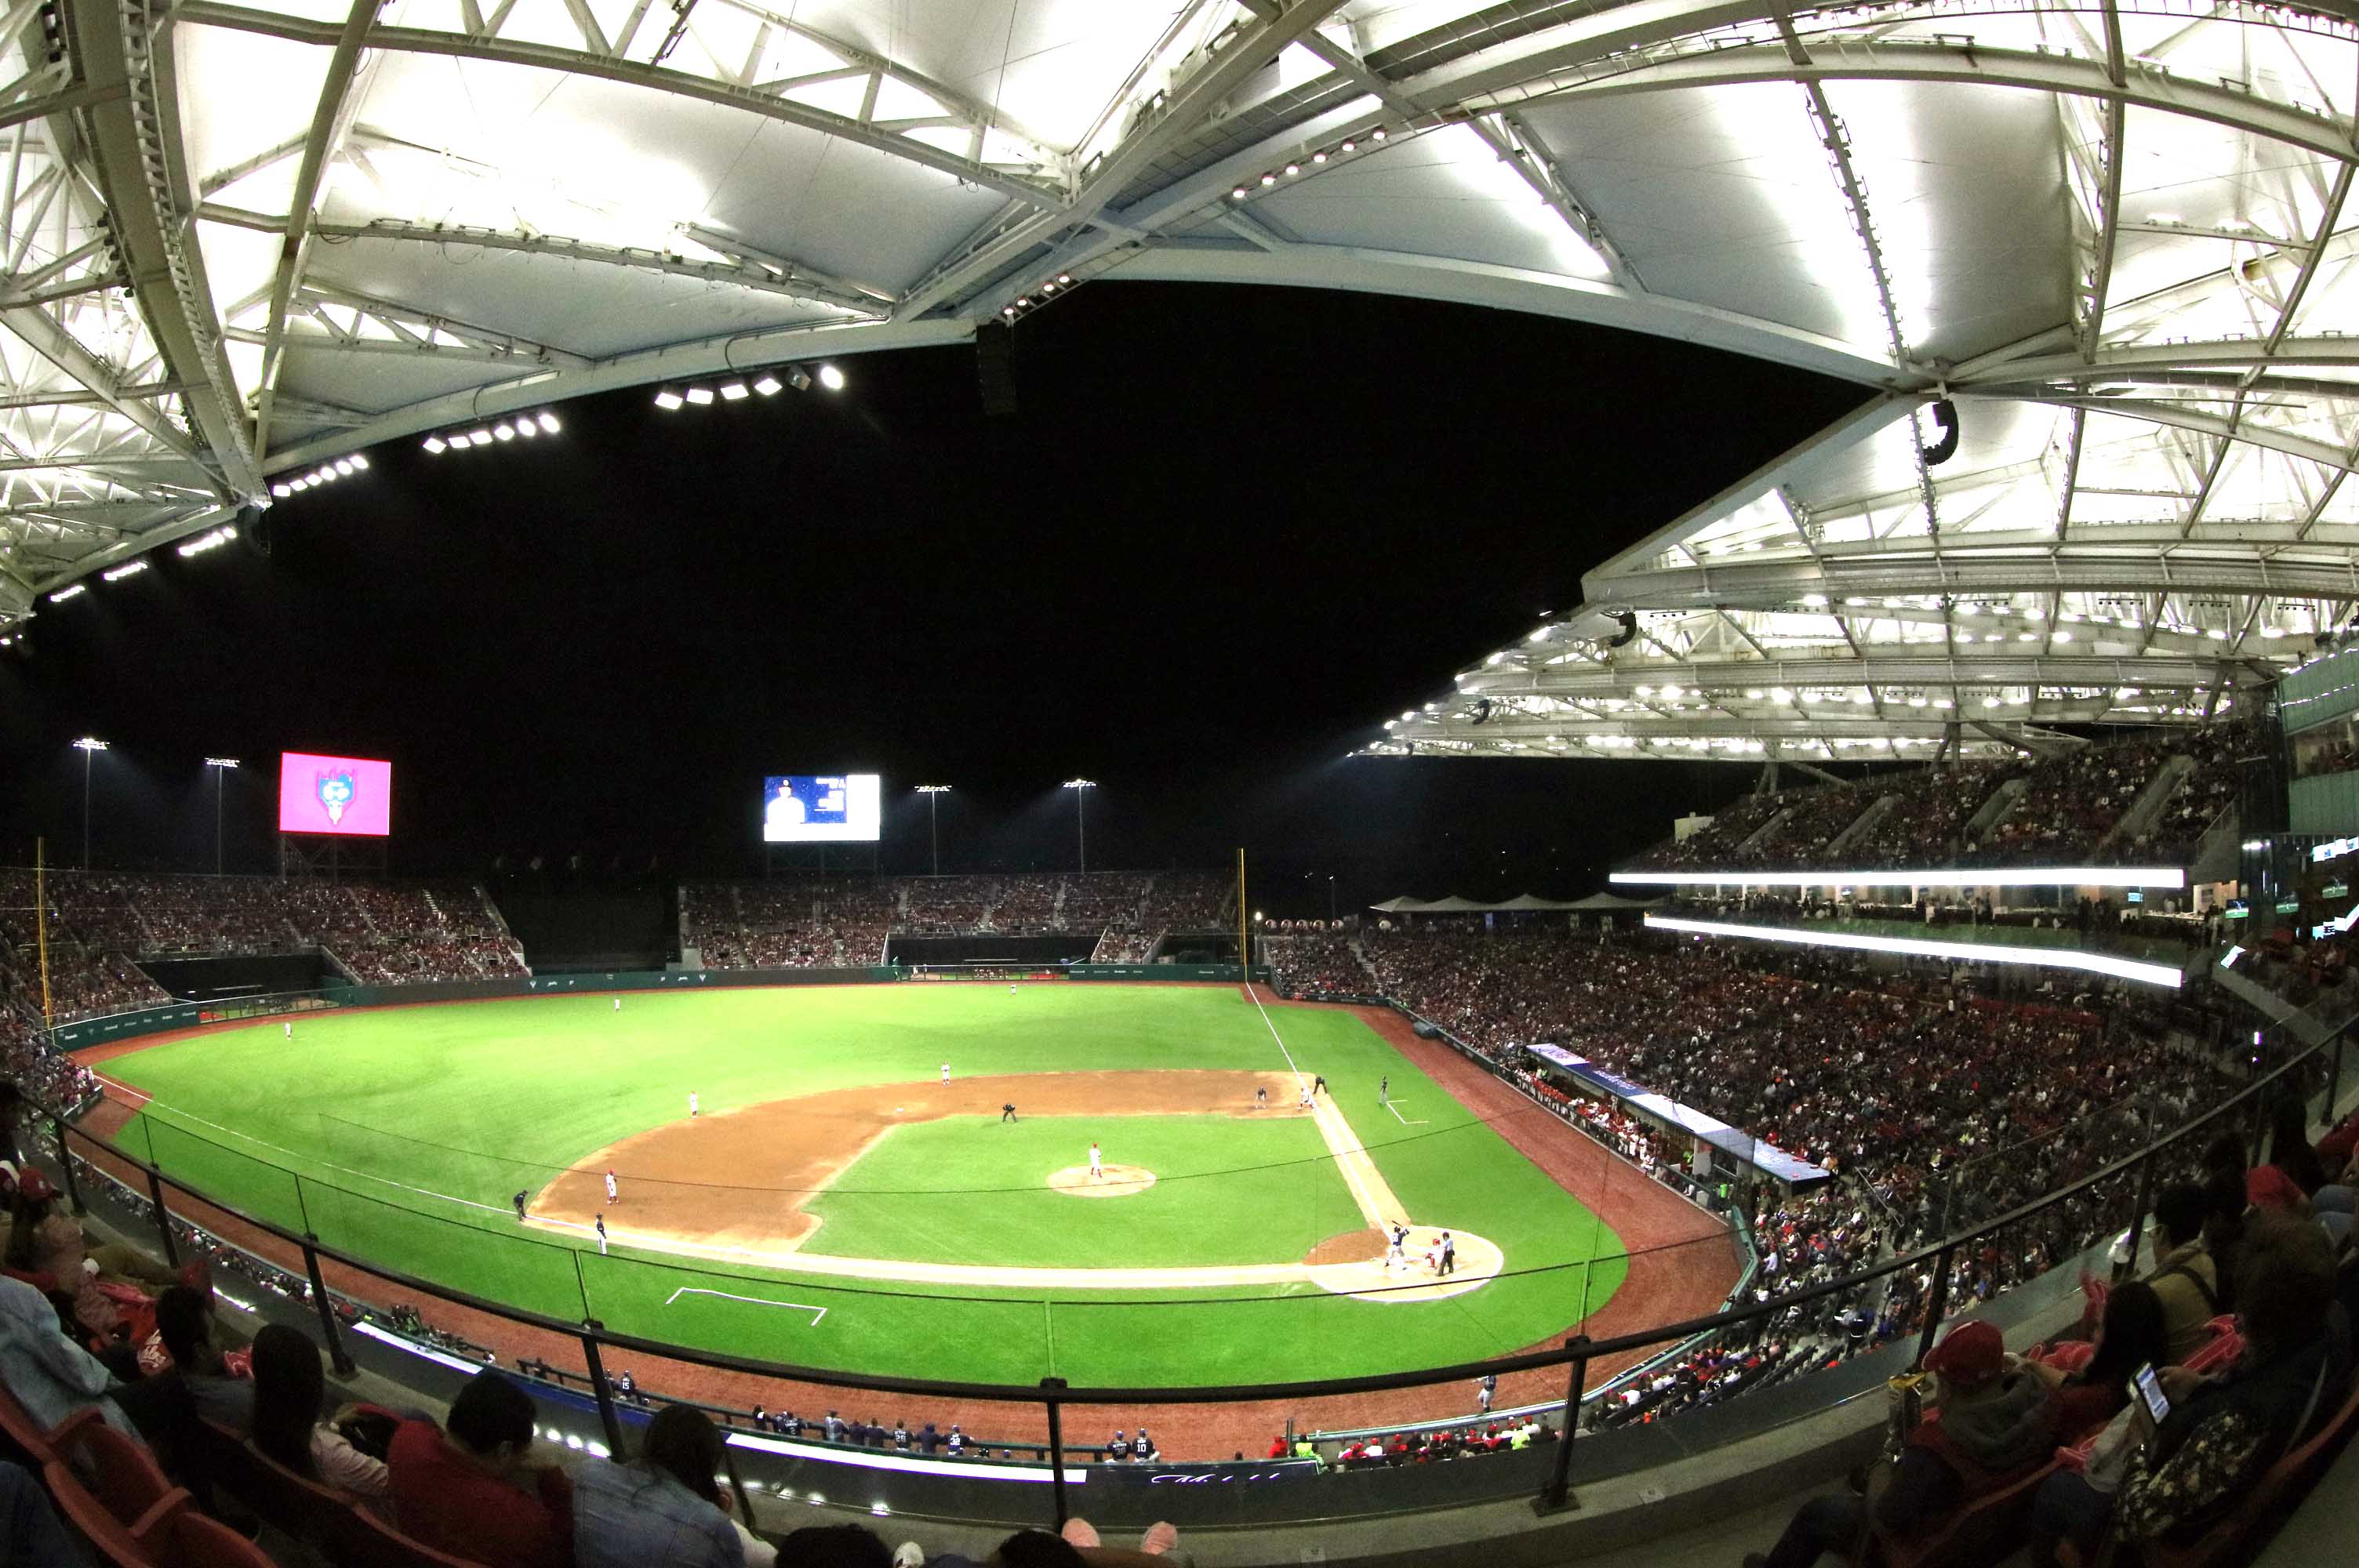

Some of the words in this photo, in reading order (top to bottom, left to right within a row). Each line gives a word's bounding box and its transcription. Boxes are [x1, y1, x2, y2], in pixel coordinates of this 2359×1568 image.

[622, 1381, 630, 1390] 15
[950, 1437, 961, 1446] 32
[1137, 1443, 1147, 1452] 10
